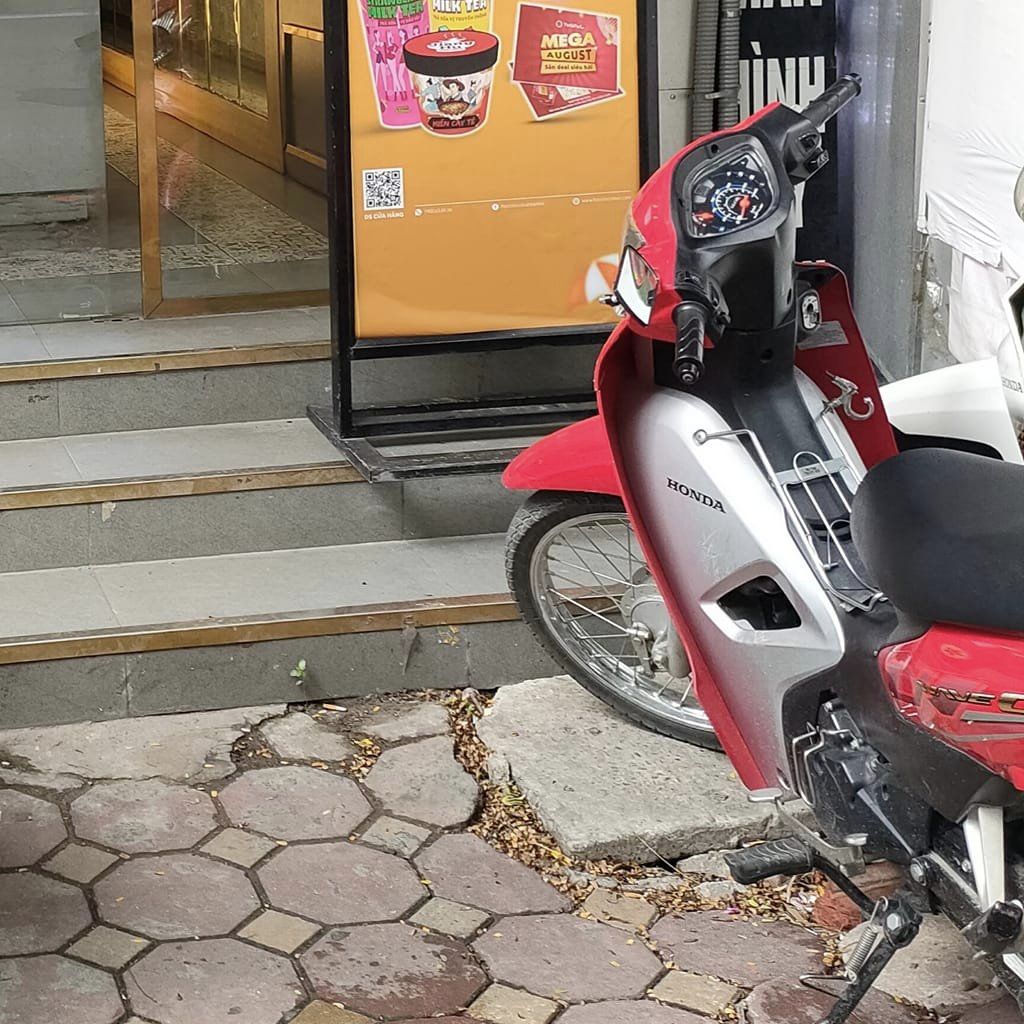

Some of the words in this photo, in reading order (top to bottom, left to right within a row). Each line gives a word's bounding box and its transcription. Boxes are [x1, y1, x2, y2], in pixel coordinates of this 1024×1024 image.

[540, 32, 596, 49] MEGA
[546, 49, 592, 61] AUGUST
[666, 477, 726, 514] HONDA
